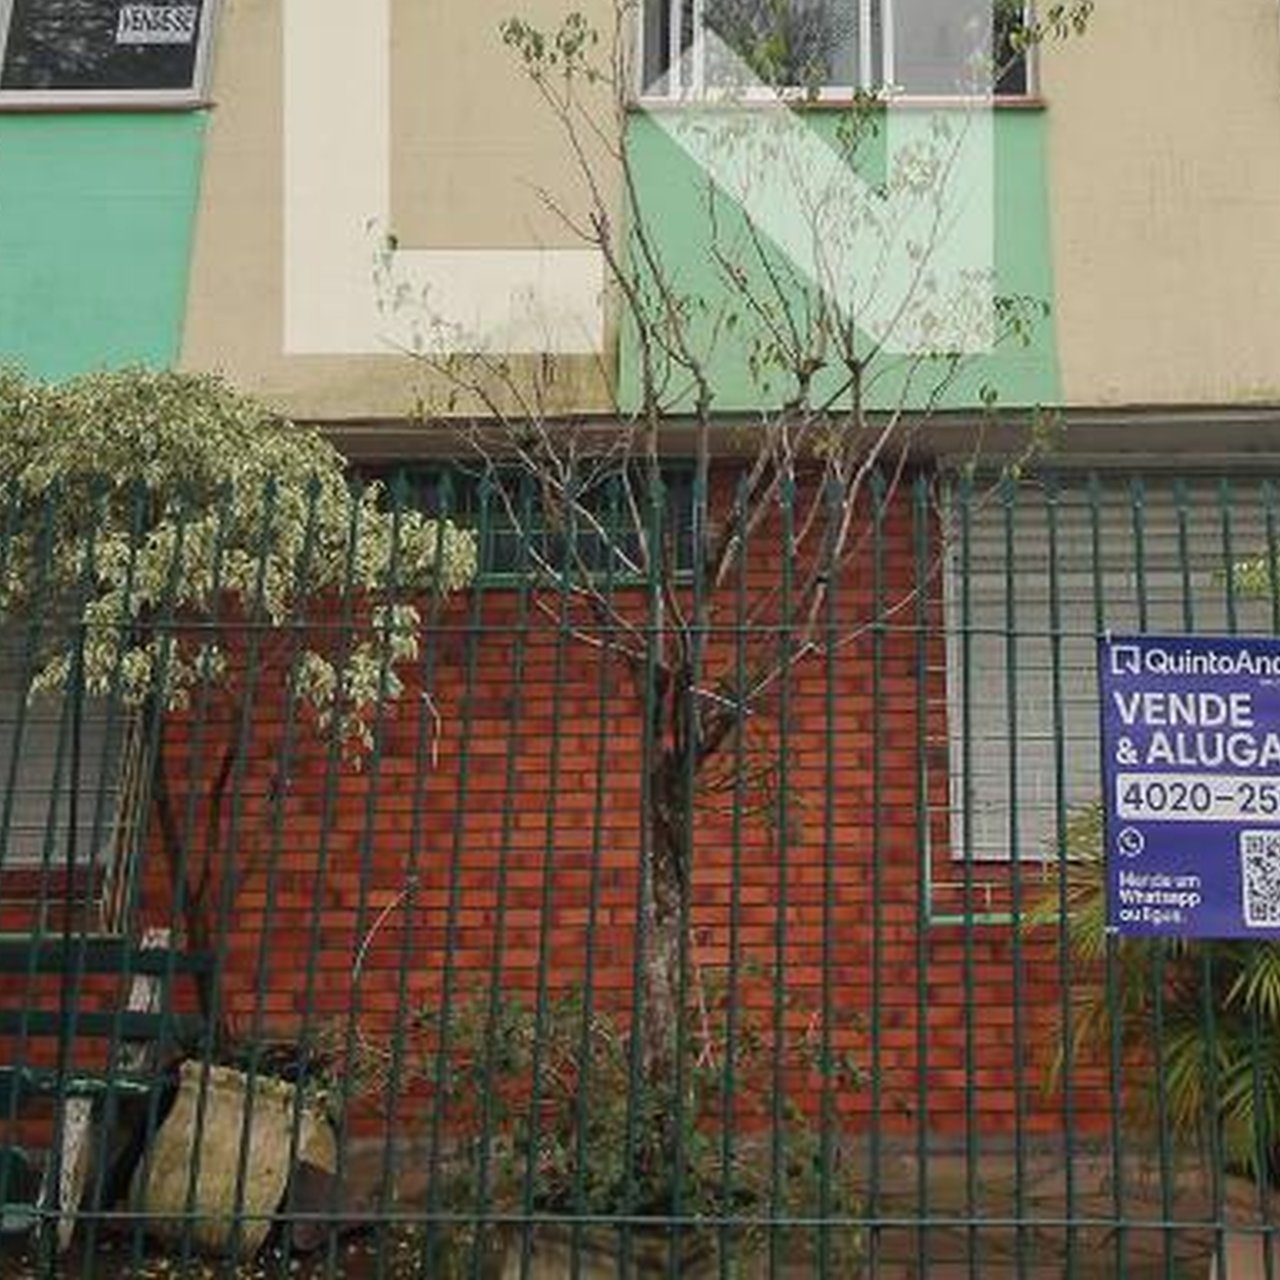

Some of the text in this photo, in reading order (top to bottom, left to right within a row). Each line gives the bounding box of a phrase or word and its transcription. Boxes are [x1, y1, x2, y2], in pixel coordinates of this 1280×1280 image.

[1113, 691, 1254, 727] VENDE
[1116, 735, 1138, 764] &
[1119, 908, 1140, 921] ou
